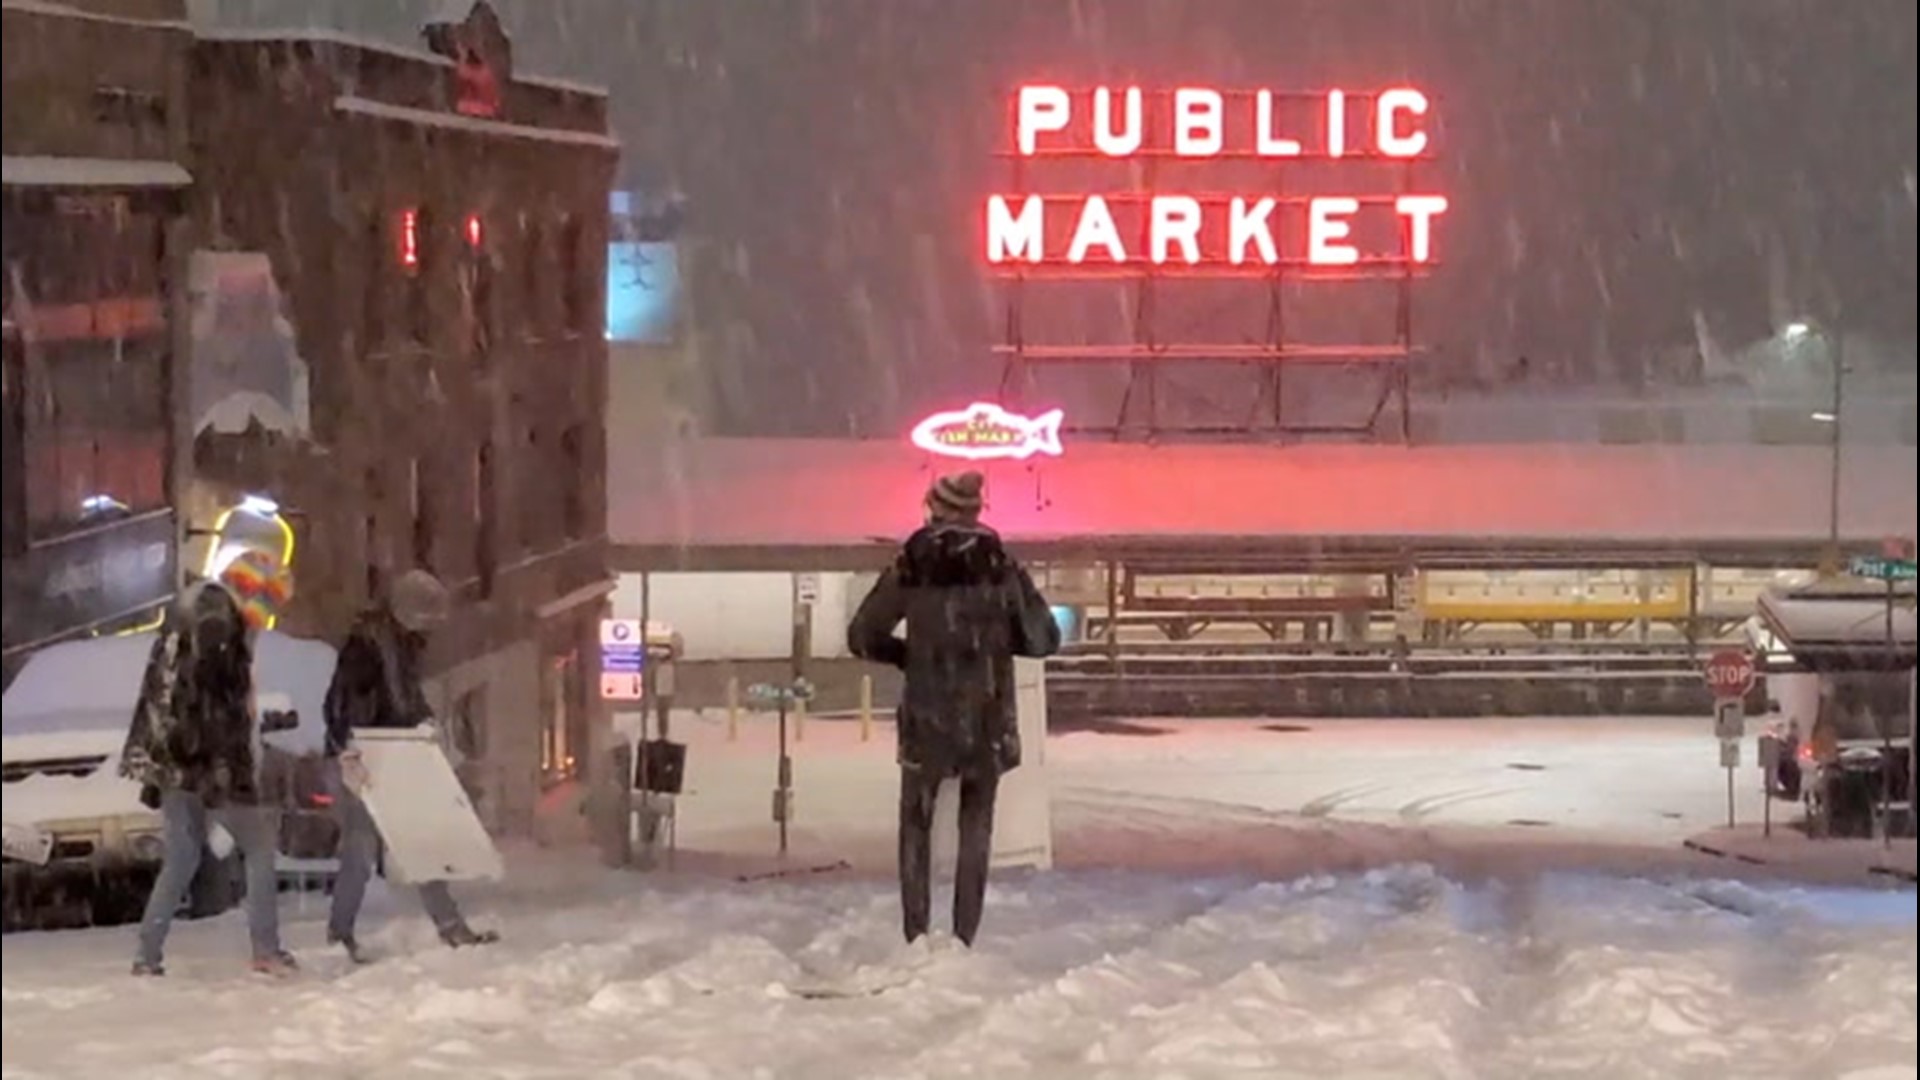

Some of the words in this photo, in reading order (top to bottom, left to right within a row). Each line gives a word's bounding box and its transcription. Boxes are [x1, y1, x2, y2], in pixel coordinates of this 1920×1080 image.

[1018, 85, 1429, 158] PUBLIC
[986, 193, 1449, 265] MARKET
[1852, 557, 1886, 577] Post
[1707, 665, 1750, 685] STOP
